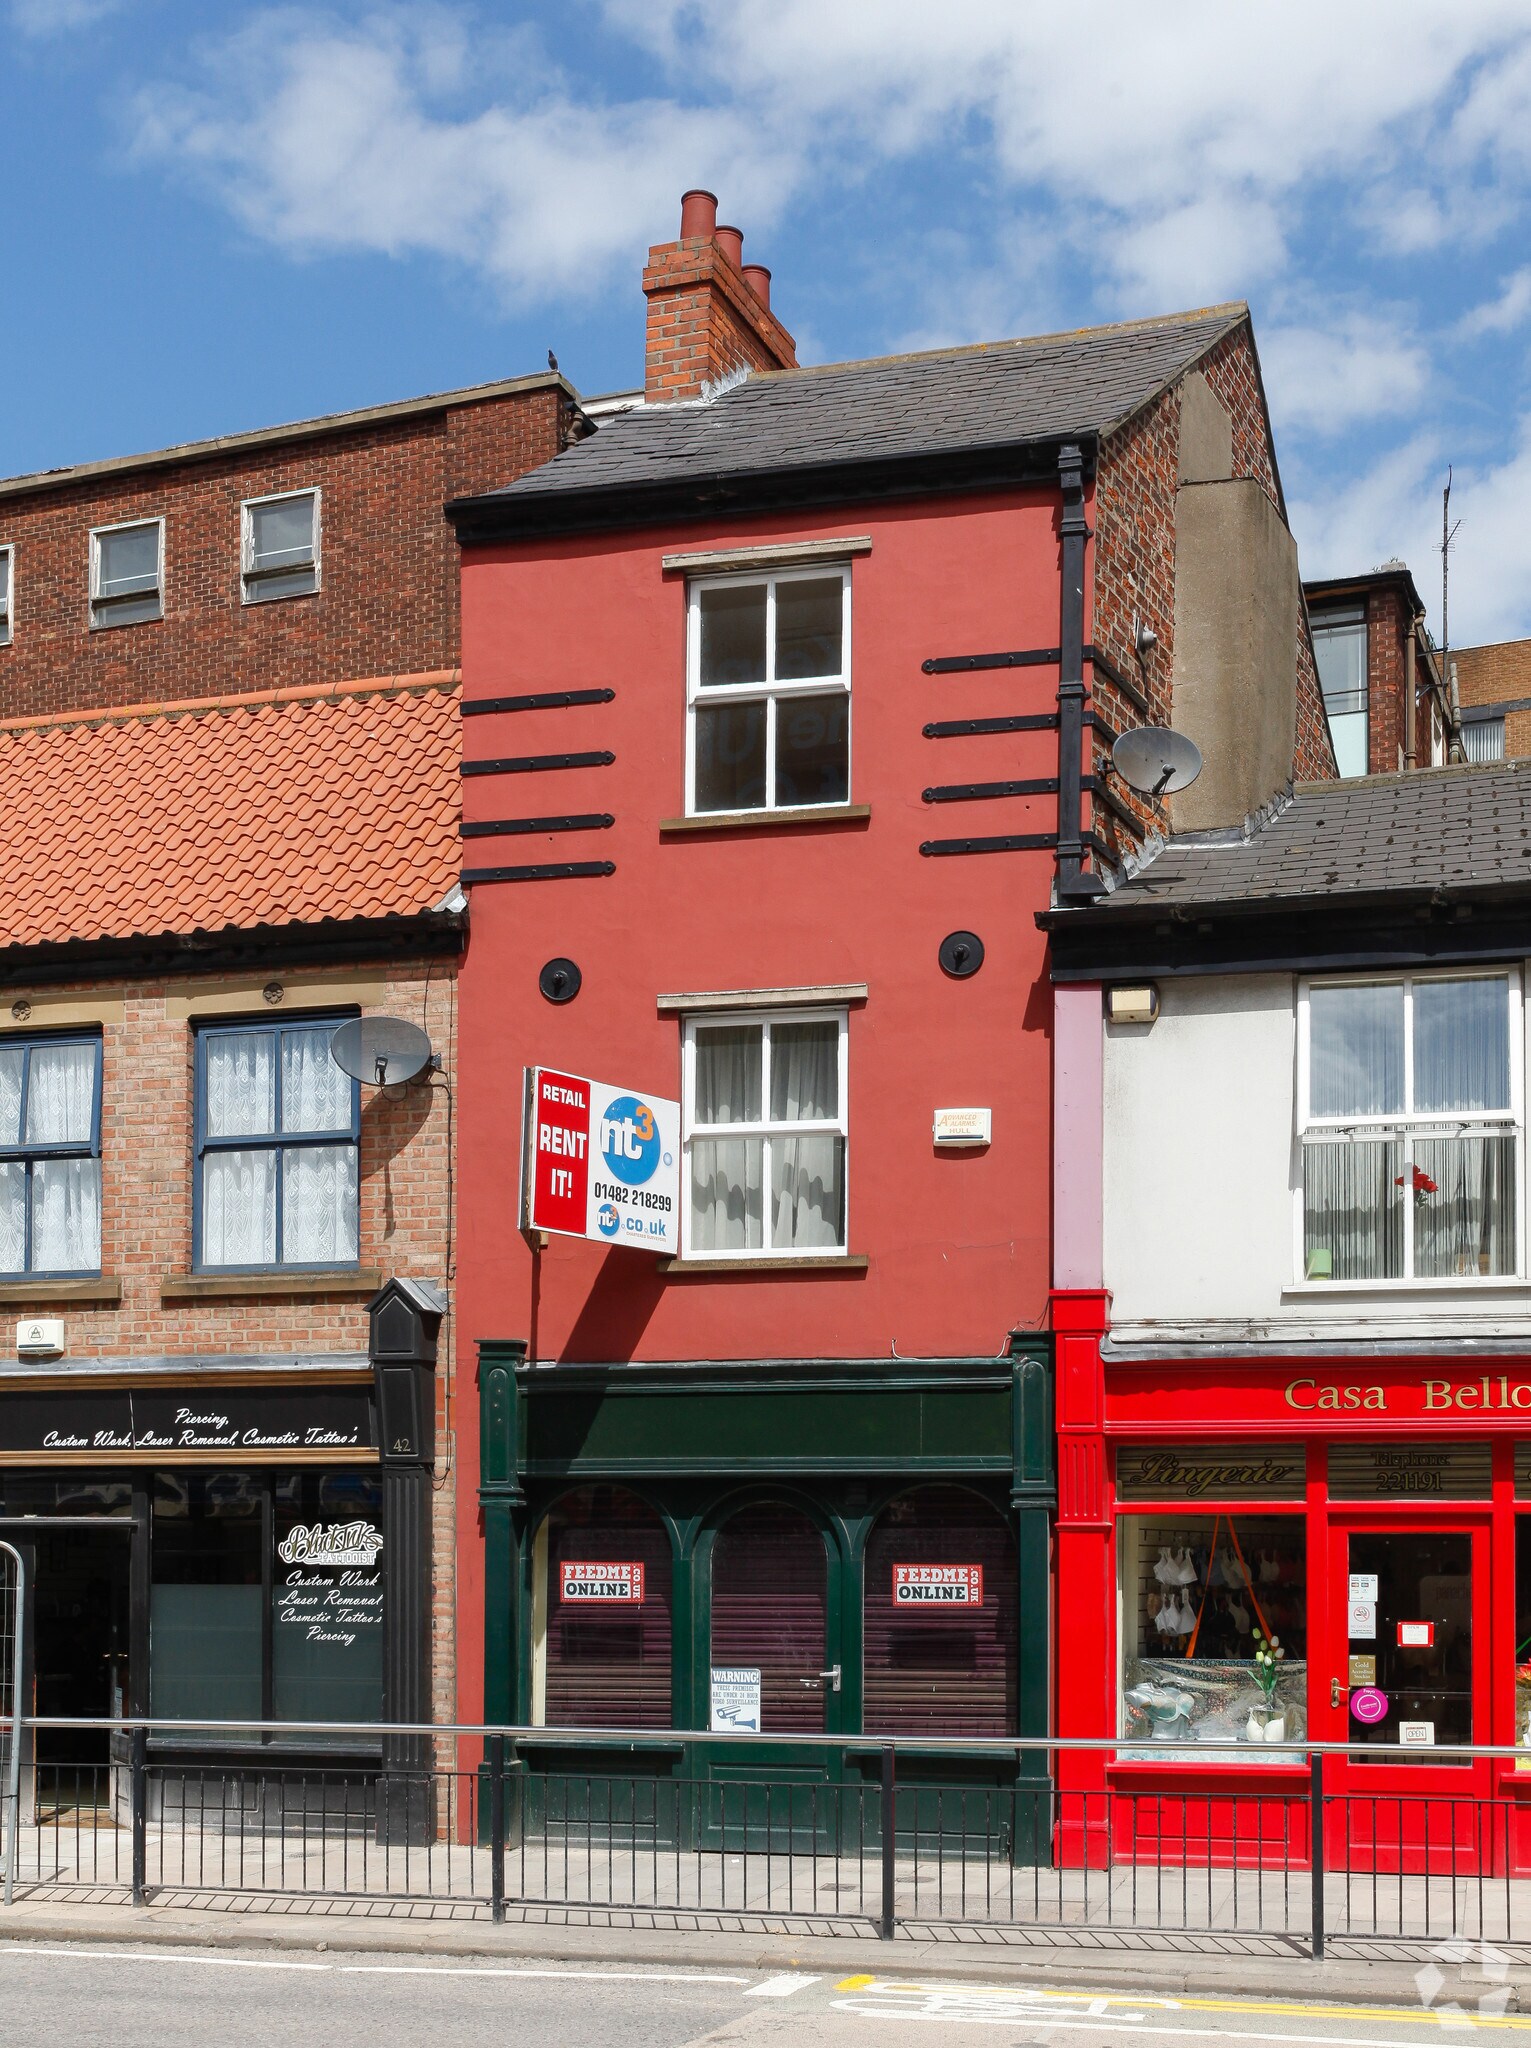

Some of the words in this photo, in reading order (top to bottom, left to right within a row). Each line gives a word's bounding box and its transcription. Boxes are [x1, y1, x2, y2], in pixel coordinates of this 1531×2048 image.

[543, 1083, 586, 1109] RETAIL
[540, 1123, 587, 1160] RENT
[551, 1168, 573, 1198] IT!
[594, 1182, 629, 1204] 01482
[632, 1189, 672, 1212] 218299
[1284, 1378, 1389, 1410] Casa
[1421, 1375, 1531, 1410] Bello
[174, 1407, 229, 1430] Piercing,
[43, 1430, 89, 1447] Custom
[93, 1430, 132, 1447] Work,
[135, 1430, 174, 1447] Laser
[177, 1429, 236, 1446] Removal,
[242, 1428, 300, 1445] Cosmetic
[304, 1426, 358, 1444] Tattoo's
[393, 1438, 411, 1452] 42
[1131, 1453, 1294, 1496] Lingerie
[1377, 1471, 1443, 1492] 221191
[318, 1551, 377, 1565] TATTOOIST
[286, 1570, 334, 1587] Custom
[339, 1571, 381, 1586] Work
[564, 1565, 632, 1580] FEEDME
[632, 1565, 641, 1599] .CO.UK
[897, 1568, 969, 1582] FEEDME
[565, 1582, 629, 1596] ONLINE
[898, 1585, 966, 1600] ONLINE
[970, 1568, 979, 1603] .CO.UK
[278, 1589, 318, 1605] Laser
[323, 1589, 383, 1605] Removal
[280, 1608, 331, 1622] Cosmetic
[336, 1608, 383, 1622] Tattoo's
[306, 1625, 356, 1647] Piercing
[713, 1671, 759, 1683] WARNING!
[726, 1698, 759, 1706] SURVEILLANCE
[1407, 1730, 1425, 1738] OPEN
